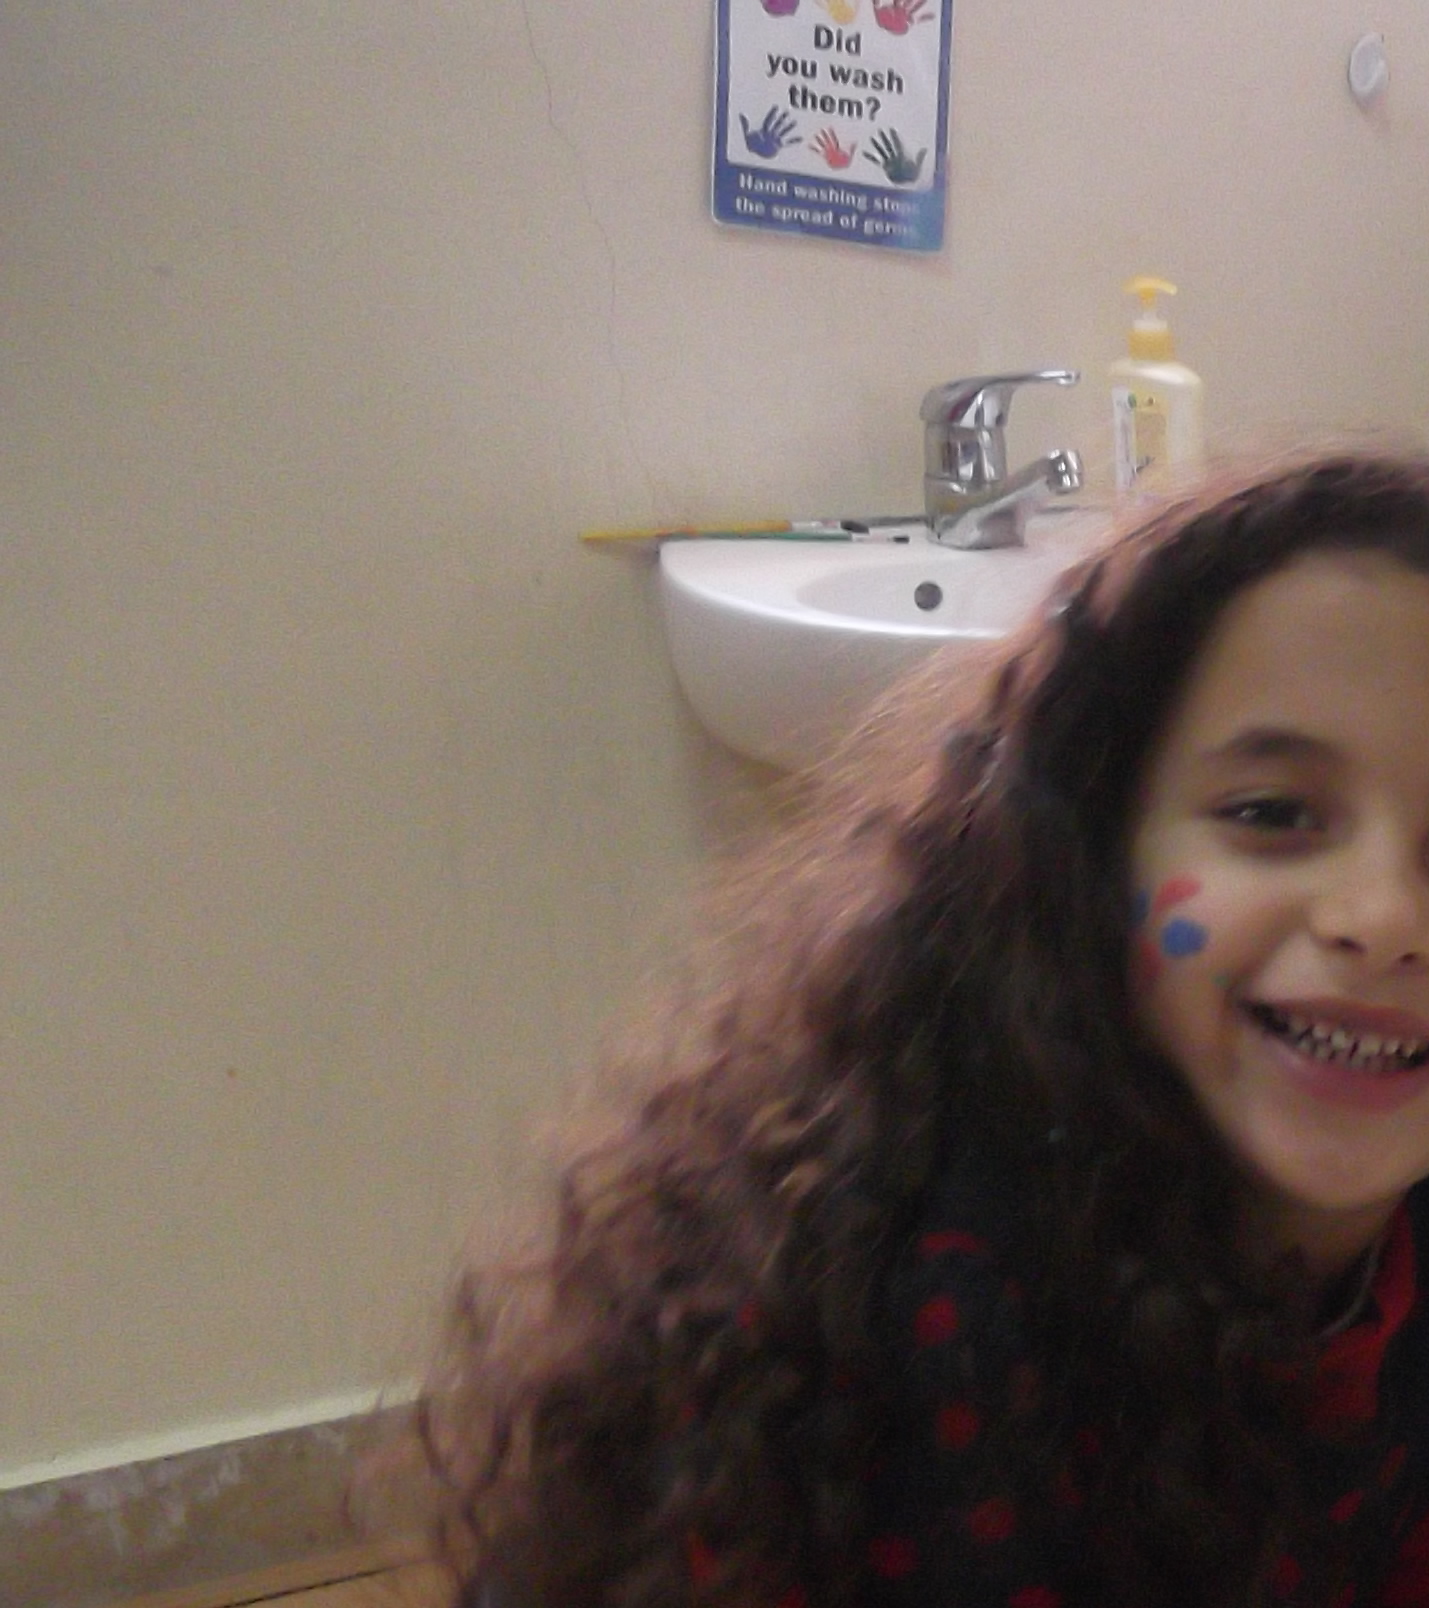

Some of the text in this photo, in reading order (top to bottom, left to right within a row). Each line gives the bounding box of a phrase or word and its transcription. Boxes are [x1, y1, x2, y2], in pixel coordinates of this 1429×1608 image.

[814, 24, 862, 56] Did
[766, 53, 904, 94] you wash
[788, 84, 882, 121] them?
[738, 173, 788, 196] Hand
[793, 185, 868, 213] washing
[735, 197, 765, 215] the
[771, 202, 833, 227] spread
[839, 210, 858, 228] of
